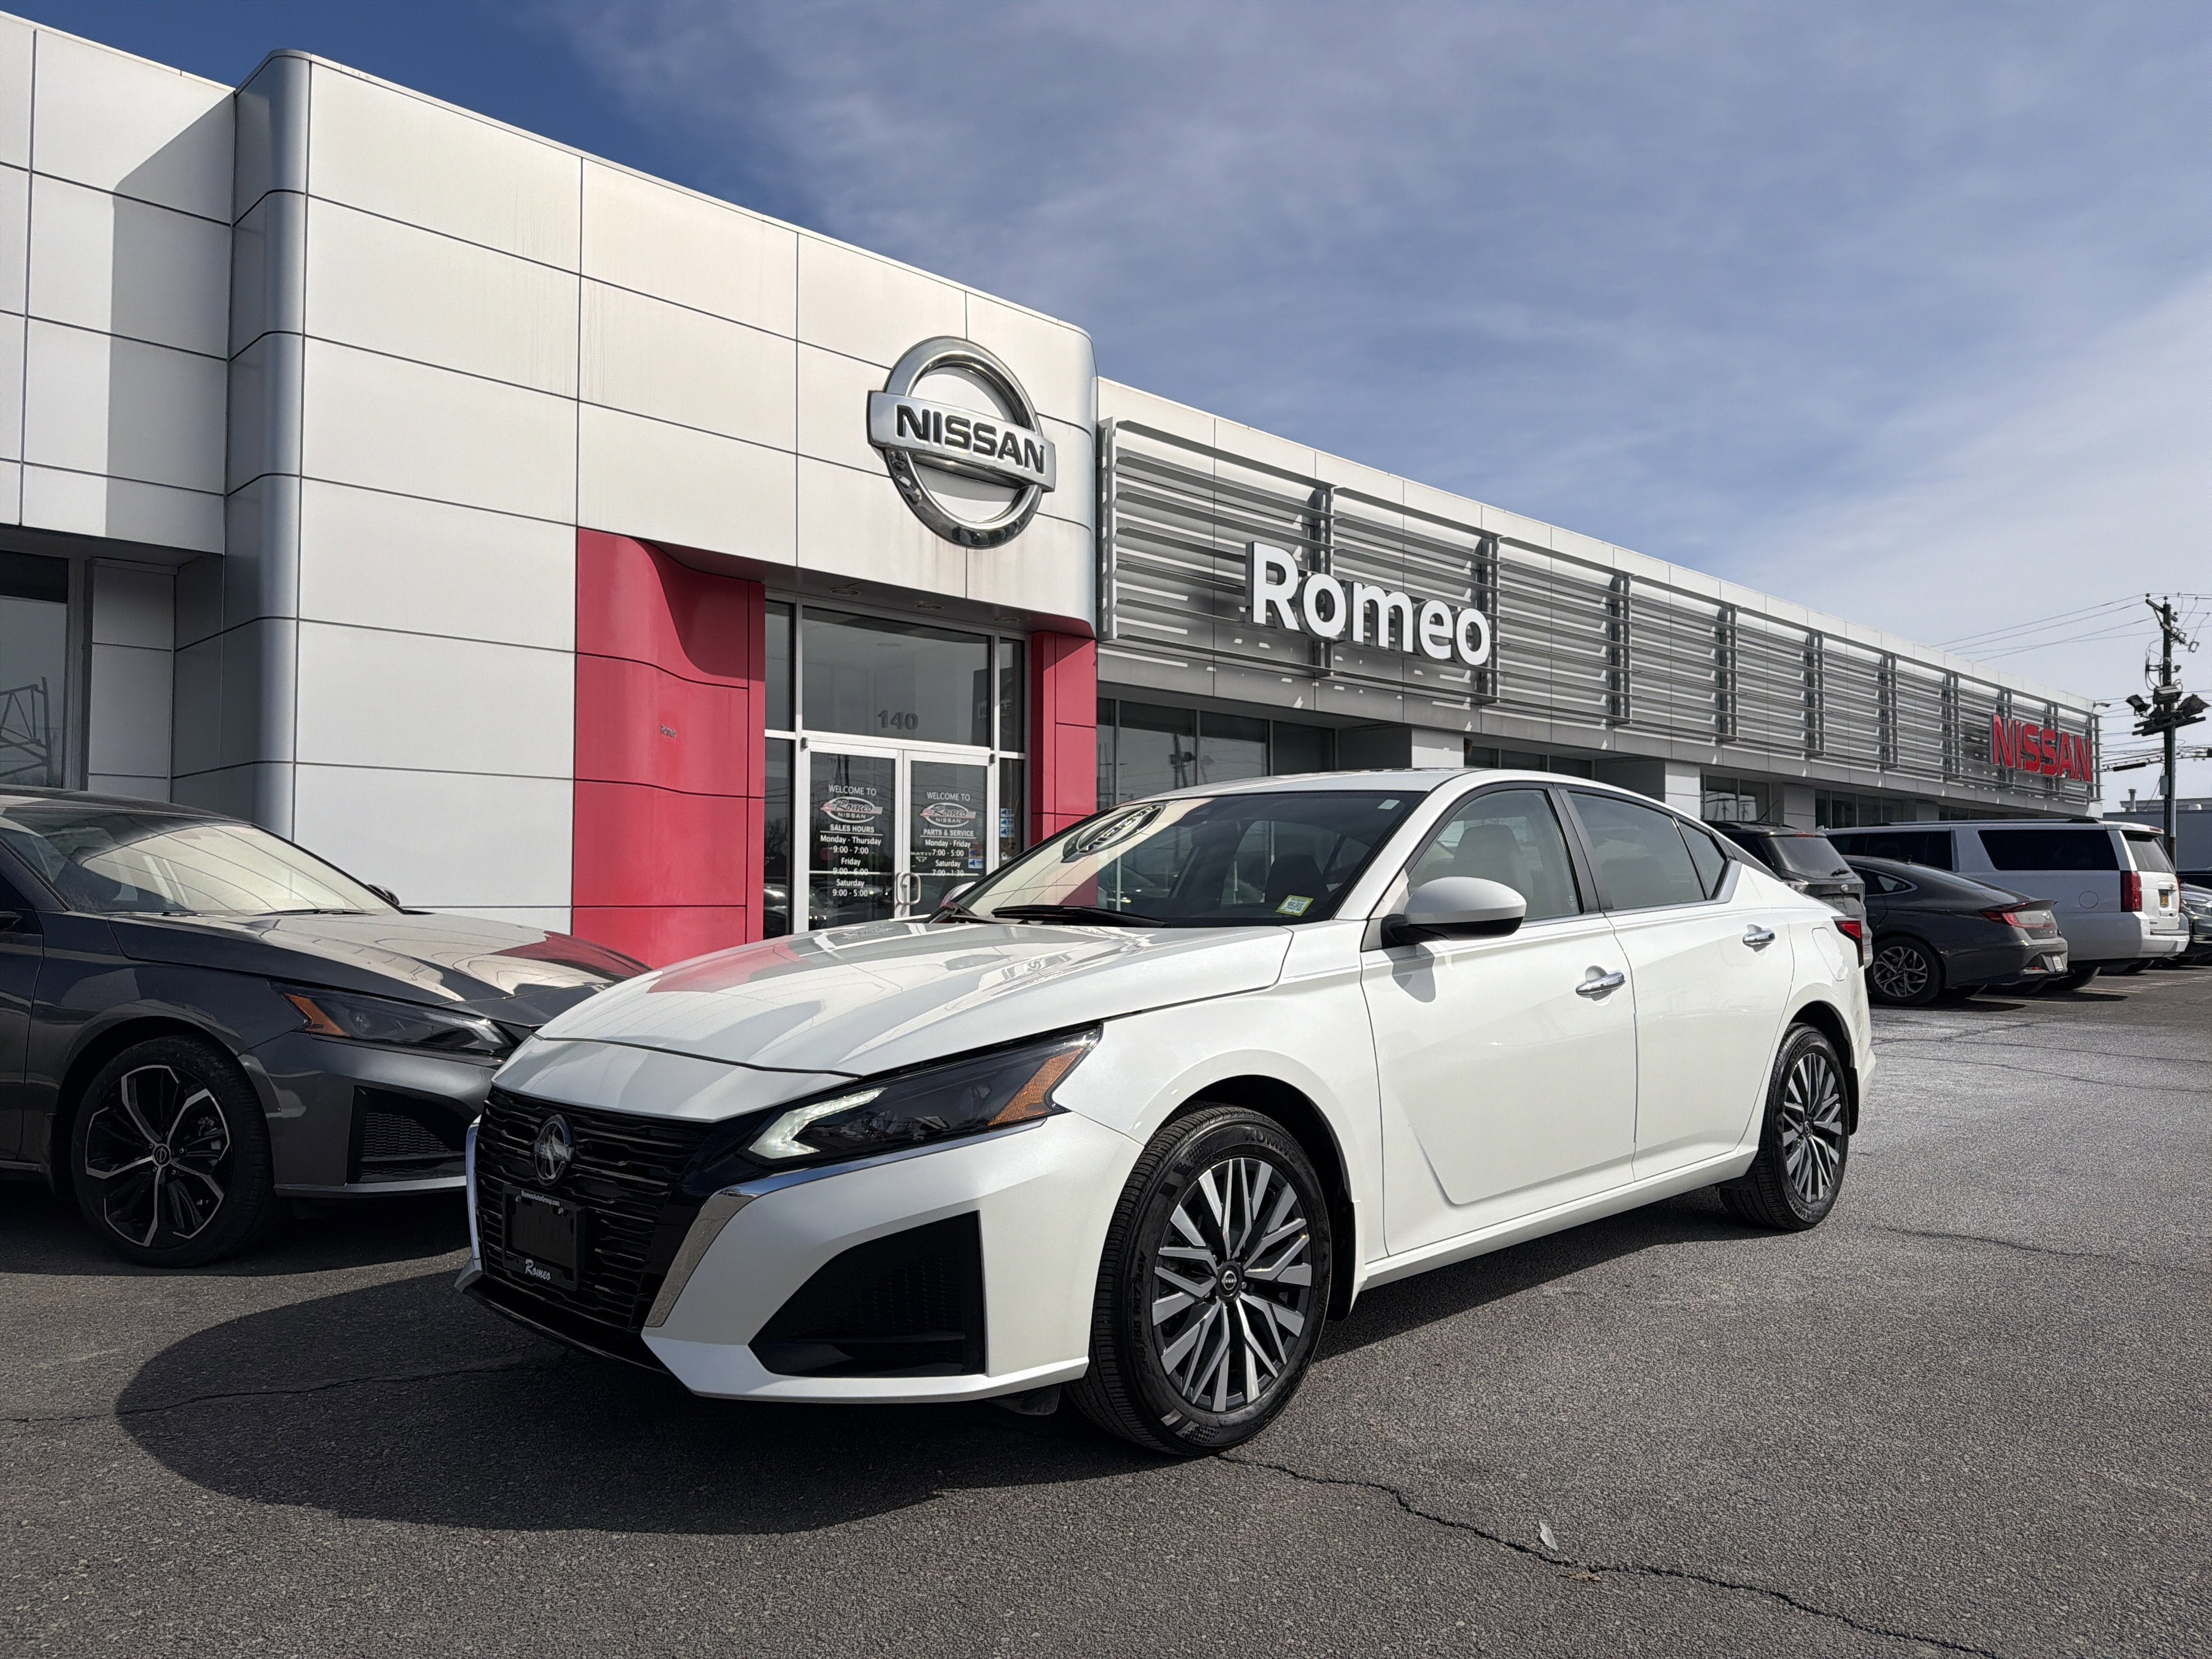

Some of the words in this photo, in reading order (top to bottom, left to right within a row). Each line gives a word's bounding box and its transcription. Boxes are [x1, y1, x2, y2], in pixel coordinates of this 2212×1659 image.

[895, 404, 1046, 475] NISSAN
[1248, 540, 1491, 667] Romeo
[878, 710, 919, 730] 140
[1991, 714, 2092, 783] NISSAN
[828, 784, 865, 795] WELCOME
[866, 788, 877, 796] TO
[927, 791, 960, 801] WELCOME
[832, 798, 873, 812] Romeo
[930, 804, 967, 817] Romeo
[830, 823, 851, 832] SALES
[820, 834, 847, 844] Monday
[851, 836, 882, 847] Thursday
[925, 839, 949, 848] Monday
[953, 839, 971, 848] Friday
[833, 845, 848, 854] 9:00
[854, 846, 869, 855] 7:00
[840, 857, 861, 866] Friday
[935, 859, 961, 868] Saturday
[833, 867, 848, 876] 9:00
[836, 878, 865, 888] Saturday
[854, 889, 868, 897] 5:00
[524, 1259, 551, 1282] Romeo
